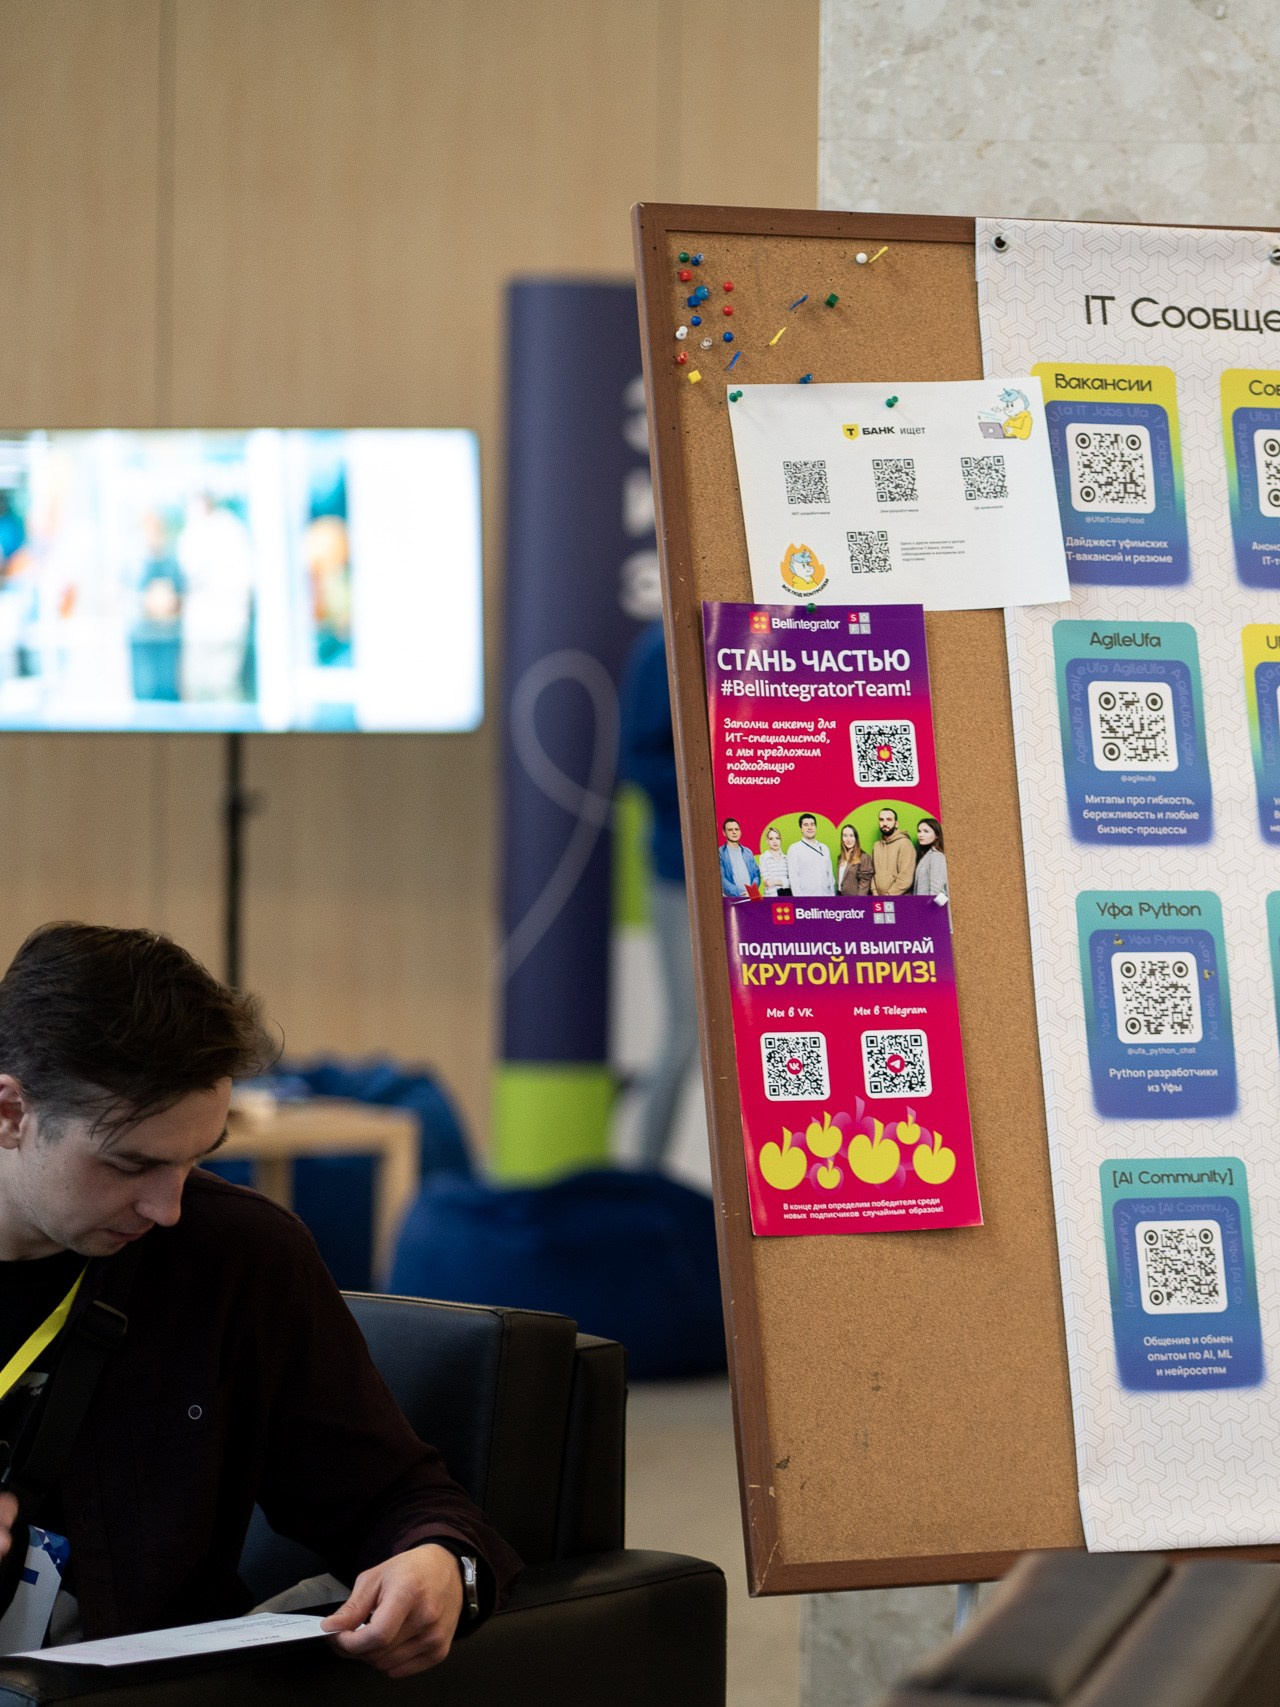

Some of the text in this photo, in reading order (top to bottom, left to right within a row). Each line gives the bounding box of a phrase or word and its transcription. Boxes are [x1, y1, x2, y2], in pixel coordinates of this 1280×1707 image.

[1084, 294, 1115, 326] IT
[1055, 373, 1153, 391] Вакансии
[862, 426, 895, 435] БАНК
[900, 426, 925, 436] ищет
[1066, 536, 1169, 549] Дайджест уфимских
[1066, 551, 1173, 564] T-вакансий и резюме
[772, 618, 840, 632] Bellintegrator
[1089, 631, 1161, 649] AgileUfa
[717, 648, 910, 673] СТАНЬ ЧАСТЬЮ
[721, 680, 912, 702] #BellintegratorTeam!
[724, 717, 836, 731] Заполни анкету для
[725, 732, 830, 745] ИТ-специалистов,
[726, 747, 821, 759] а мы предложим
[727, 761, 795, 773] подходящую
[728, 775, 781, 785] вакансию
[1085, 795, 1125, 805] Митапы
[1127, 796, 1145, 807] про
[1083, 809, 1199, 821] бережливость и любые
[1098, 824, 1187, 837] бизнес-процессы
[795, 908, 865, 922] Bellintegrator
[1097, 902, 1201, 919] Уфа Python
[739, 937, 934, 959] ПОДПИШИСЬ И ВЫИГРАЙ
[741, 956, 937, 985] КРУТОЙ ПРИЗ!
[767, 1007, 814, 1018] Мы в VK
[853, 1005, 927, 1018] Мы в Telegram
[1109, 1068, 1218, 1080] Python разработчики
[1148, 1082, 1182, 1094] из Уфы
[1113, 1168, 1234, 1188] [AI Community]
[791, 1203, 811, 1211] конце
[813, 1203, 826, 1211] дня
[828, 1202, 870, 1211] определим
[872, 1198, 916, 1209] победителя
[918, 1198, 940, 1207] среди
[784, 1206, 943, 1220] новых подписчиков случайным образом!
[1143, 1334, 1233, 1347] Общение и обмен
[1148, 1352, 1188, 1362] опытом
[1189, 1352, 1201, 1360] по
[1218, 1350, 1233, 1359] ML
[1156, 1365, 1227, 1378] и нейросетям
